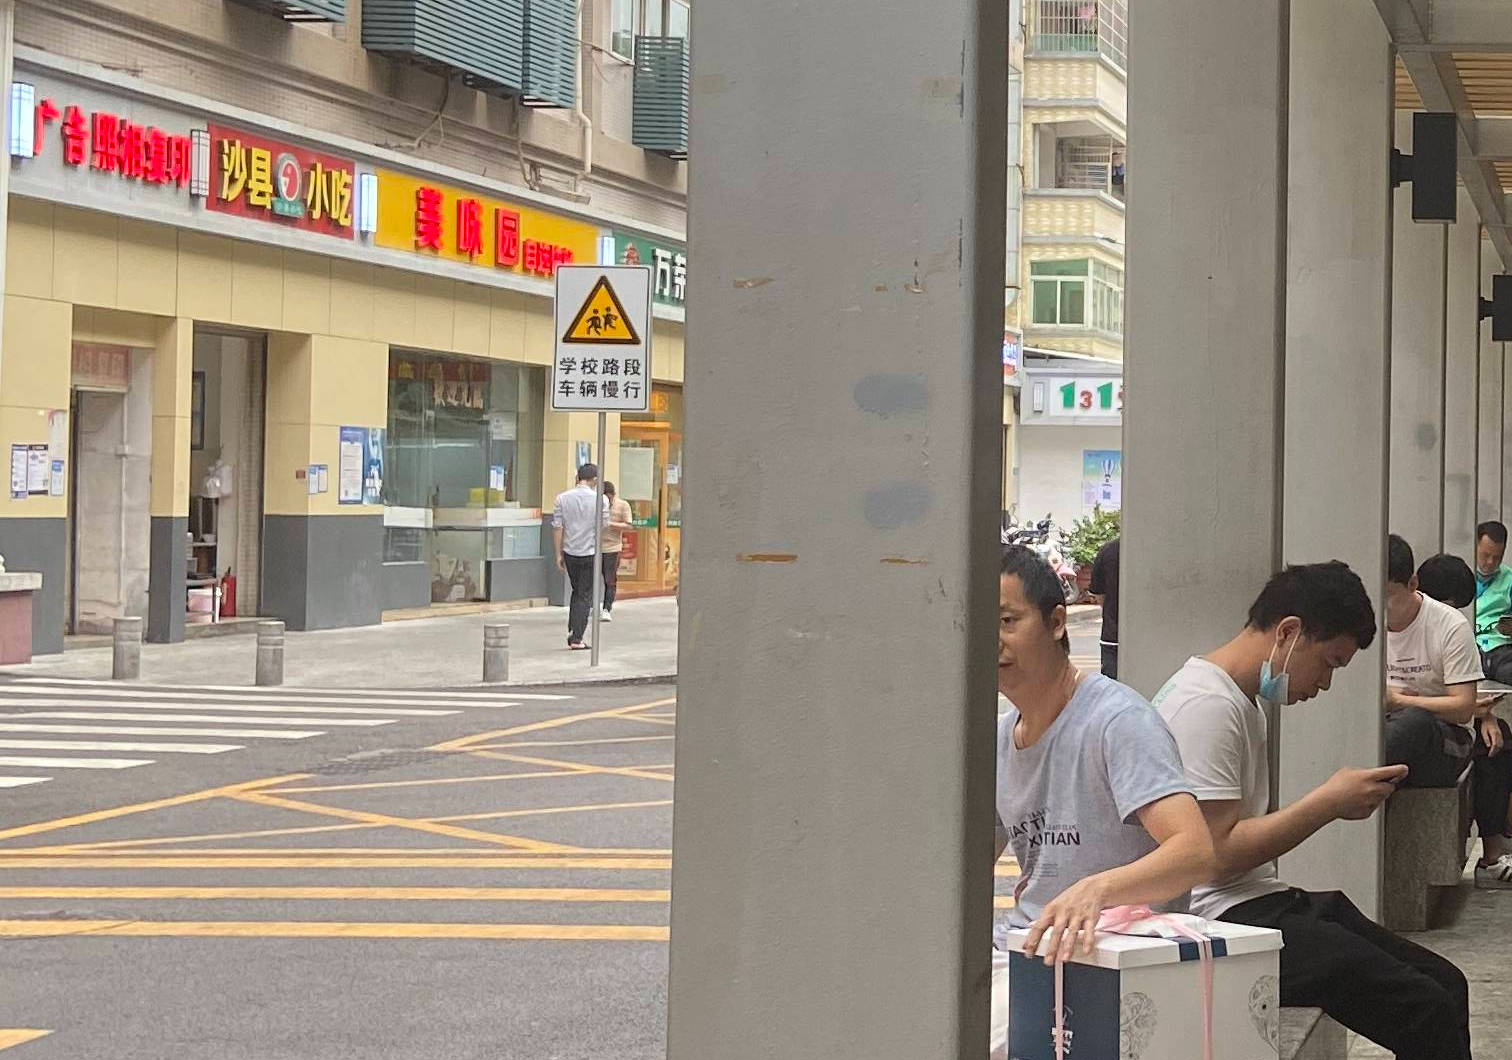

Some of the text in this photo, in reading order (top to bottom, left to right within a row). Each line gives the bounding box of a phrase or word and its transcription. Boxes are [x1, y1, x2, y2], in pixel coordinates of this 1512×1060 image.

[415, 186, 520, 267] 美味园
[559, 357, 642, 377] 学校路段
[558, 379, 642, 400] 车辆慢行
